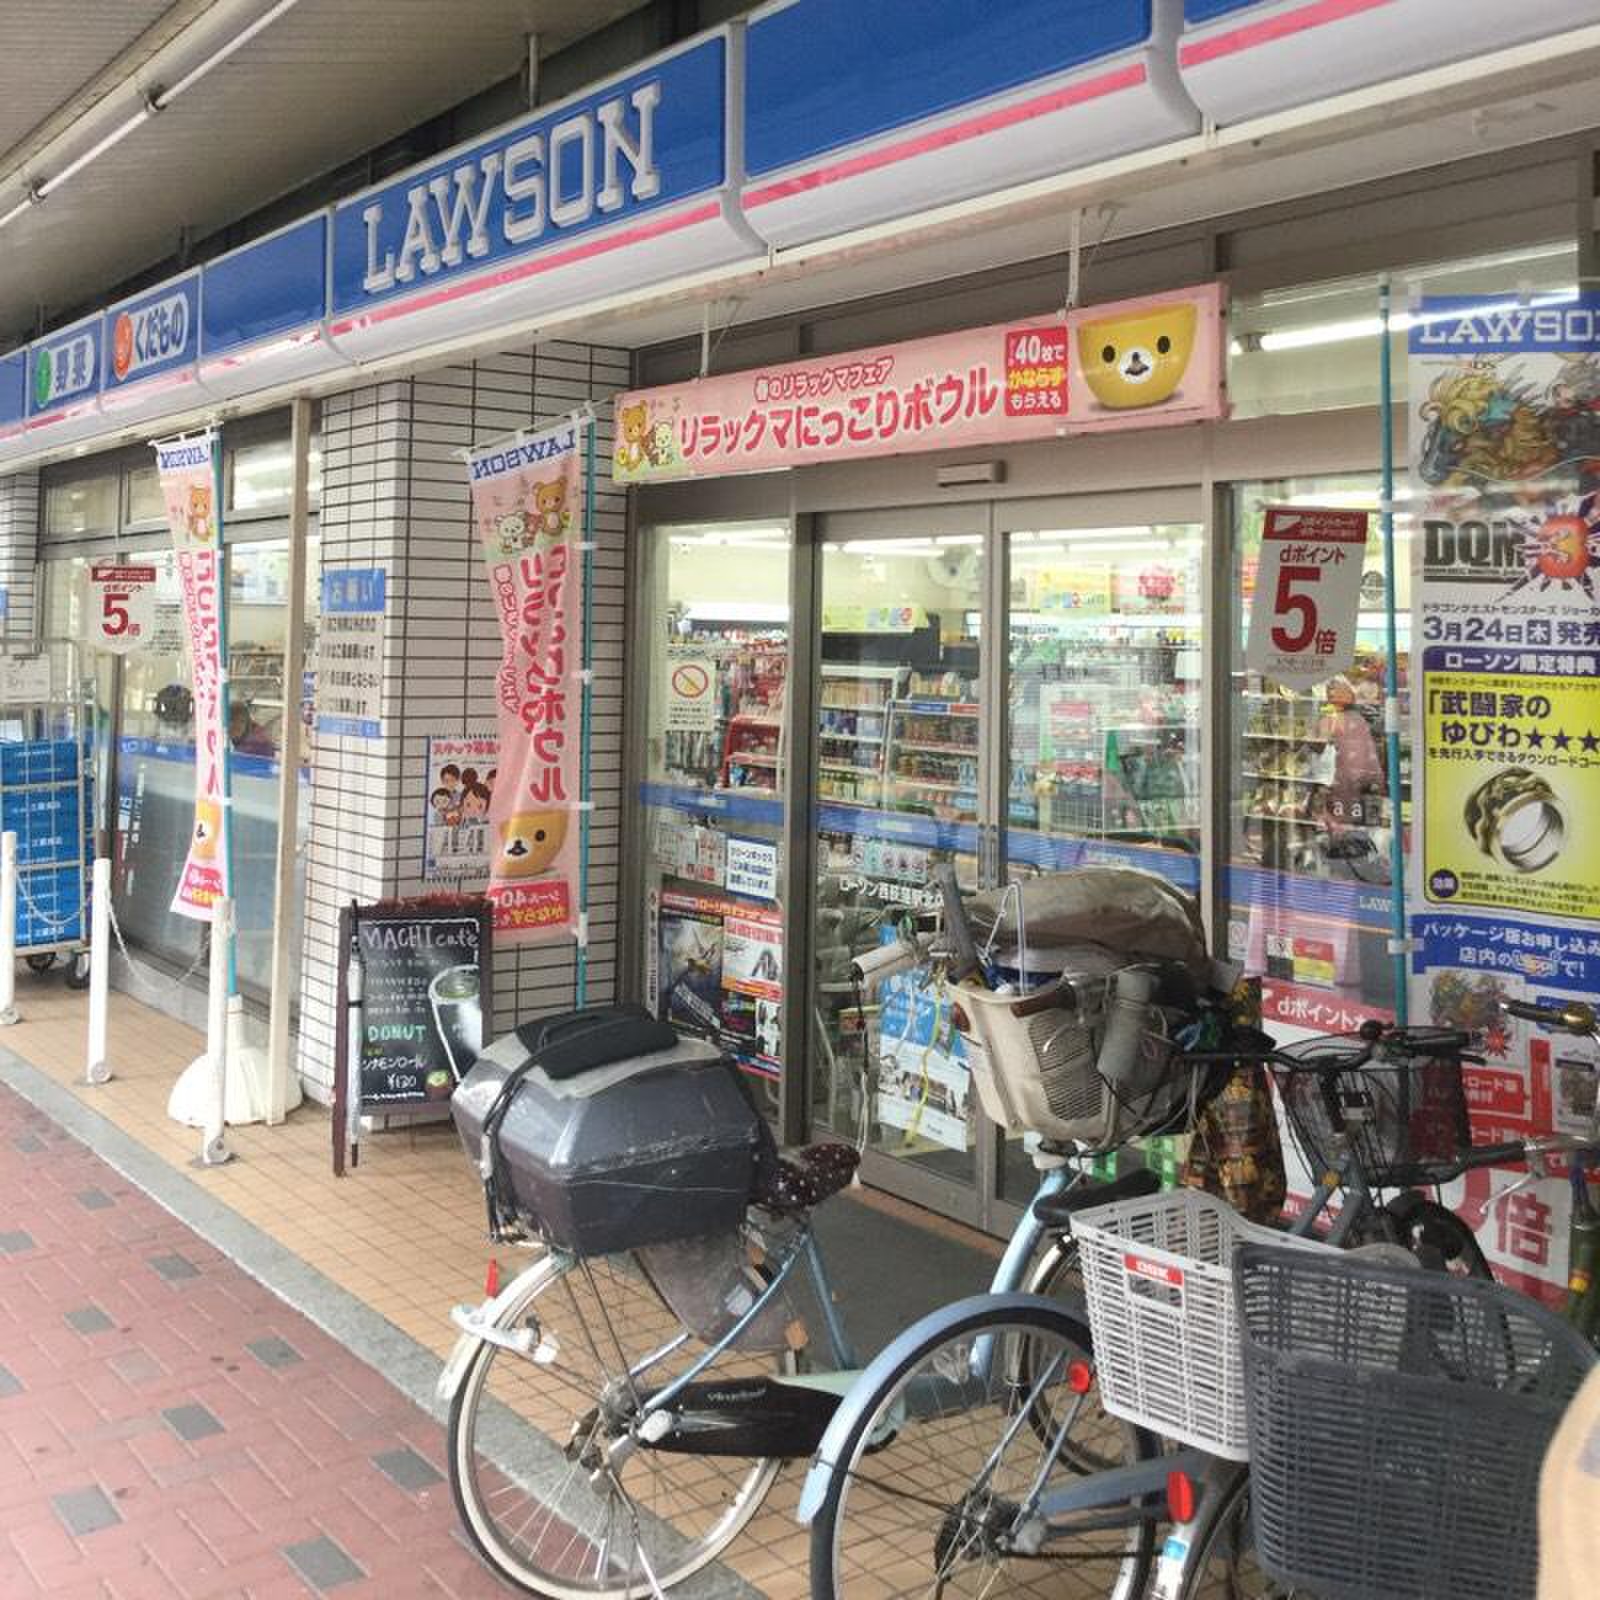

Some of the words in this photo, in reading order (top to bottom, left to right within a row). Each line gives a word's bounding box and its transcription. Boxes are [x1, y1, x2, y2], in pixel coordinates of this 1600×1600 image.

[363, 80, 660, 293] LAWSON
[135, 302, 185, 361] くだもの
[1419, 309, 1600, 344] LAWSO
[1008, 366, 1065, 390] かならず
[681, 367, 998, 458] リラックマにっこりボウル
[1010, 390, 1062, 410] もらえる
[1279, 543, 1346, 565] dポイント
[1271, 565, 1338, 655] 5倍
[365, 925, 433, 950] MACHI
[367, 1023, 427, 1043] DONUT
